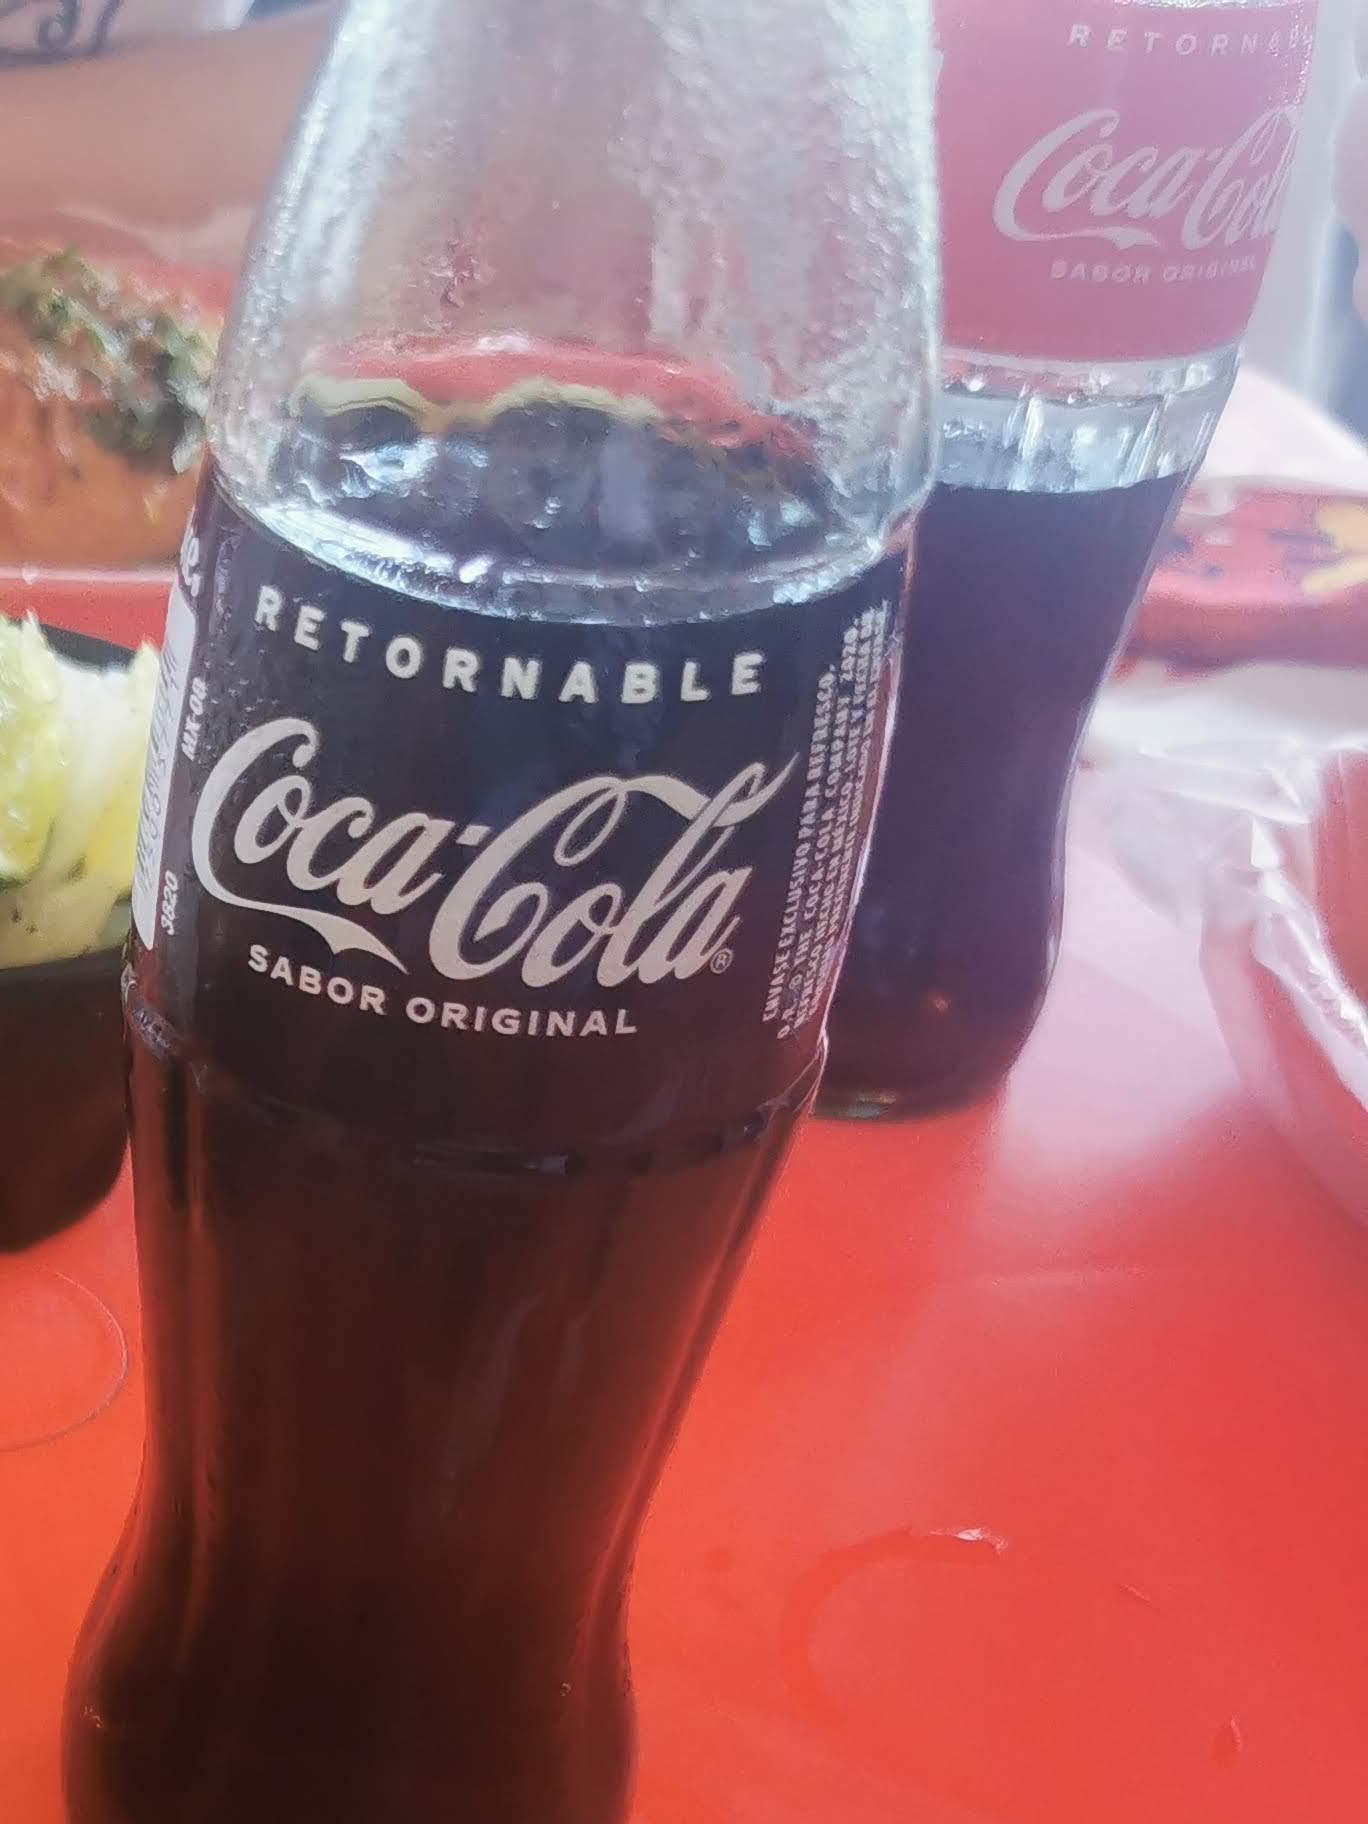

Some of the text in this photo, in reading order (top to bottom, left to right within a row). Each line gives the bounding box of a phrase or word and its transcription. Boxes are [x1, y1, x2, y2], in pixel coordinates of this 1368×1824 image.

[254, 585, 767, 704] RETORNABLE
[192, 716, 800, 988] Coca-Cola
[762, 950, 790, 1021] ENVASE
[778, 843, 810, 948] EXCLUSIVO
[798, 783, 820, 838] PARA
[794, 931, 812, 967] THE
[804, 809, 836, 919] COCA-COLA
[824, 697, 850, 797] COMPANY
[247, 943, 639, 1037] SABOR ORIGINAL
